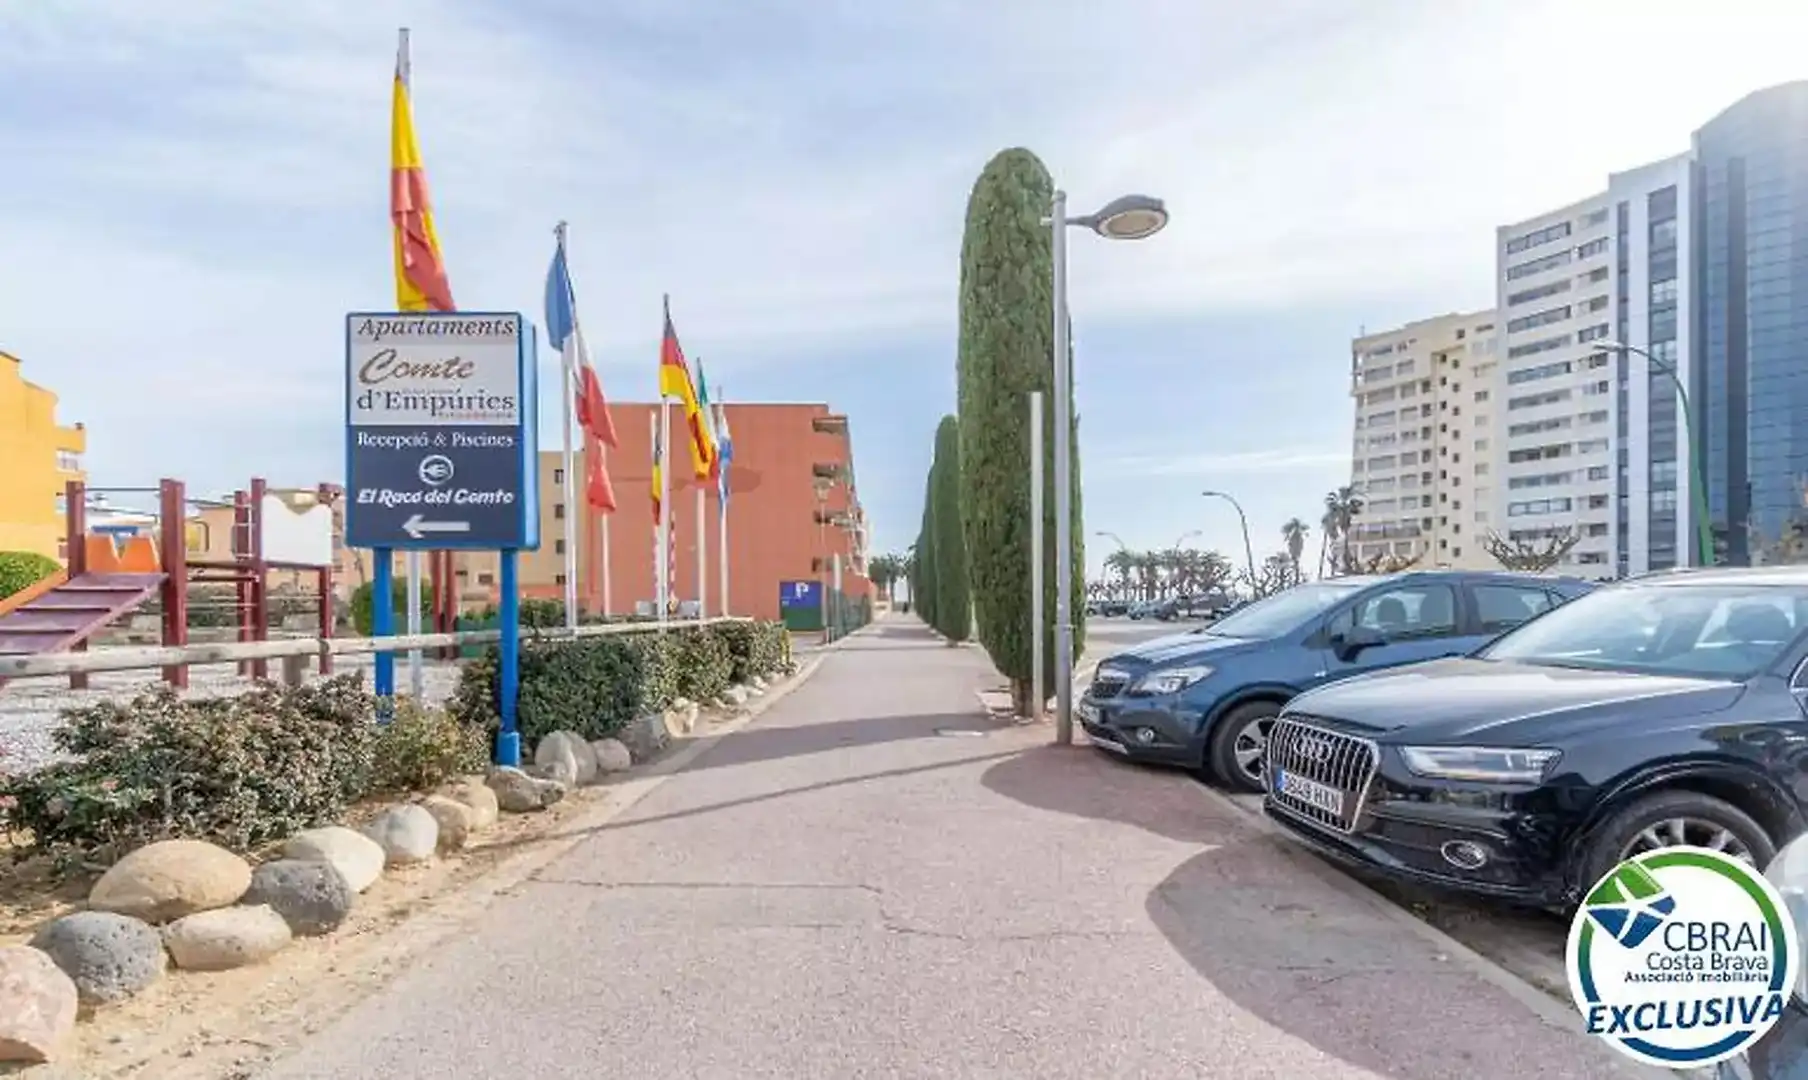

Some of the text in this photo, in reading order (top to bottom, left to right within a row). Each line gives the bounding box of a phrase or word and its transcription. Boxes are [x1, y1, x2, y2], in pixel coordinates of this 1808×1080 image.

[357, 318, 515, 341] Apartaments
[358, 348, 475, 385] Comte
[358, 431, 514, 450] Recepció & Piscines
[357, 488, 377, 504] El
[424, 488, 453, 504] del
[454, 488, 515, 504] Comte
[795, 582, 809, 598] P
